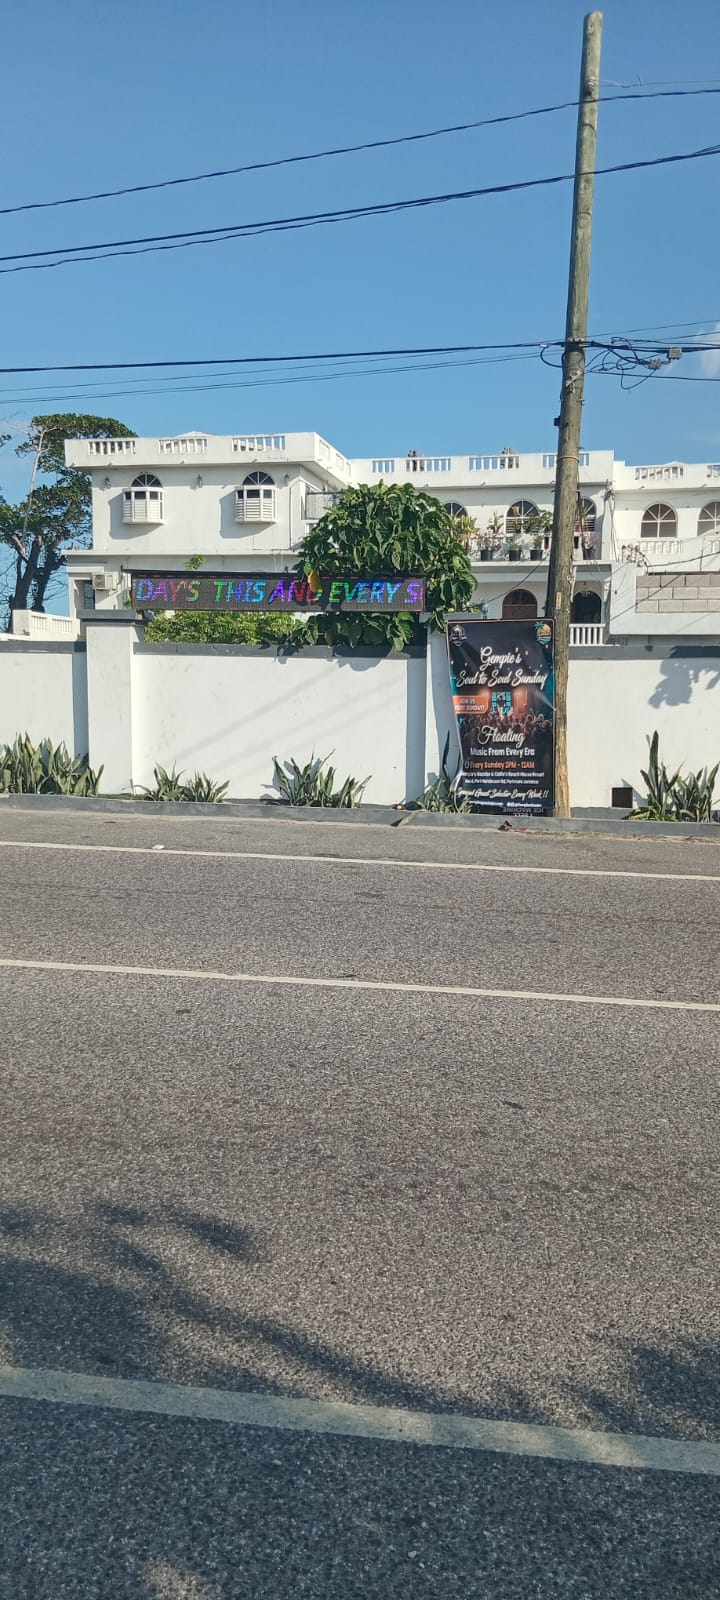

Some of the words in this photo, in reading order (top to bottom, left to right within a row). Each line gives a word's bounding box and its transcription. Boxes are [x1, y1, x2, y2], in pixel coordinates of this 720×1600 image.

[132, 579, 200, 601] DAY'S
[213, 580, 266, 602] THIS
[329, 582, 402, 603] EVERY
[404, 582, 423, 603] S
[480, 647, 522, 670] Gempie's
[456, 671, 479, 688] Soul
[479, 672, 487, 684] to
[488, 669, 512, 687] Soul
[511, 669, 548, 690] Sunday
[478, 725, 525, 748] Floating
[470, 747, 487, 756] Music
[488, 748, 505, 756] From
[506, 747, 523, 758] Every
[525, 747, 535, 756] Era
[484, 761, 505, 770] Sunday
